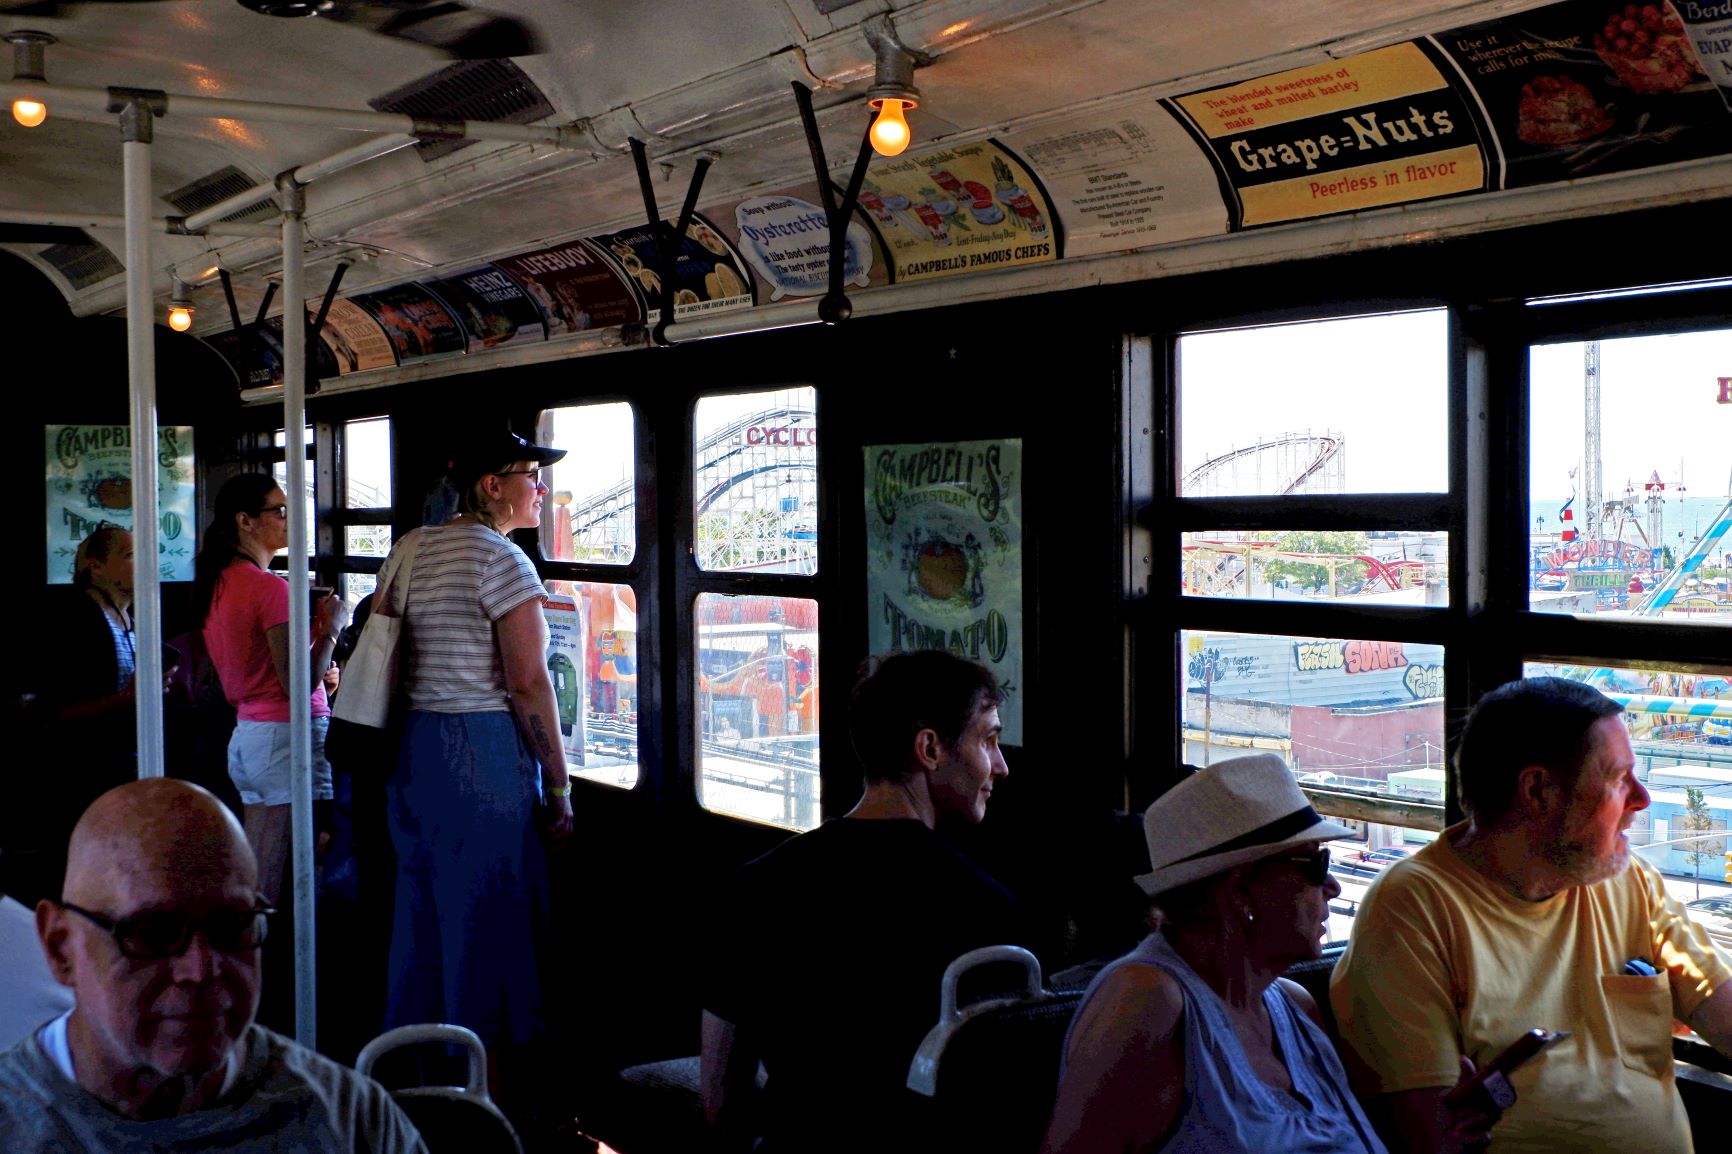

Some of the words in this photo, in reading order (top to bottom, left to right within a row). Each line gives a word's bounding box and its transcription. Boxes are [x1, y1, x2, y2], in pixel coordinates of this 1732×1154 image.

[1457, 39, 1483, 52] Use
[1487, 34, 1500, 46] it
[1468, 44, 1525, 62] wherever
[1543, 34, 1582, 51] recipe
[1477, 61, 1507, 75] calls
[1509, 55, 1530, 68] for
[1203, 98, 1226, 110] The
[1228, 86, 1273, 104] blended
[1275, 73, 1333, 93] sweetness
[1336, 68, 1350, 81] of
[1216, 106, 1249, 120] wheat
[1251, 99, 1273, 113] and
[1276, 89, 1316, 107] malted
[1318, 79, 1360, 100] barley
[1224, 117, 1255, 131] make
[1310, 173, 1378, 200] Peerless
[1384, 168, 1401, 186] in
[1404, 159, 1458, 185] flavor
[742, 204, 766, 216] Soup
[765, 199, 793, 212] without
[516, 246, 595, 276] LIFEBUOY
[770, 249, 786, 263] like
[786, 247, 803, 260] food
[776, 265, 789, 275] The
[789, 261, 806, 274] tasty
[807, 259, 827, 272] oyster
[907, 254, 967, 276] CAMPBELL'S
[970, 248, 1012, 267] FAMOUS
[1014, 243, 1050, 260] CHEFS
[464, 271, 513, 295] HEINZ
[481, 286, 523, 304] VINEGARS
[747, 427, 816, 446] CYCLO
[875, 444, 1001, 525] CAMPBELL'S
[1545, 540, 1651, 570] WONDER
[883, 592, 1008, 664] TOMATO
